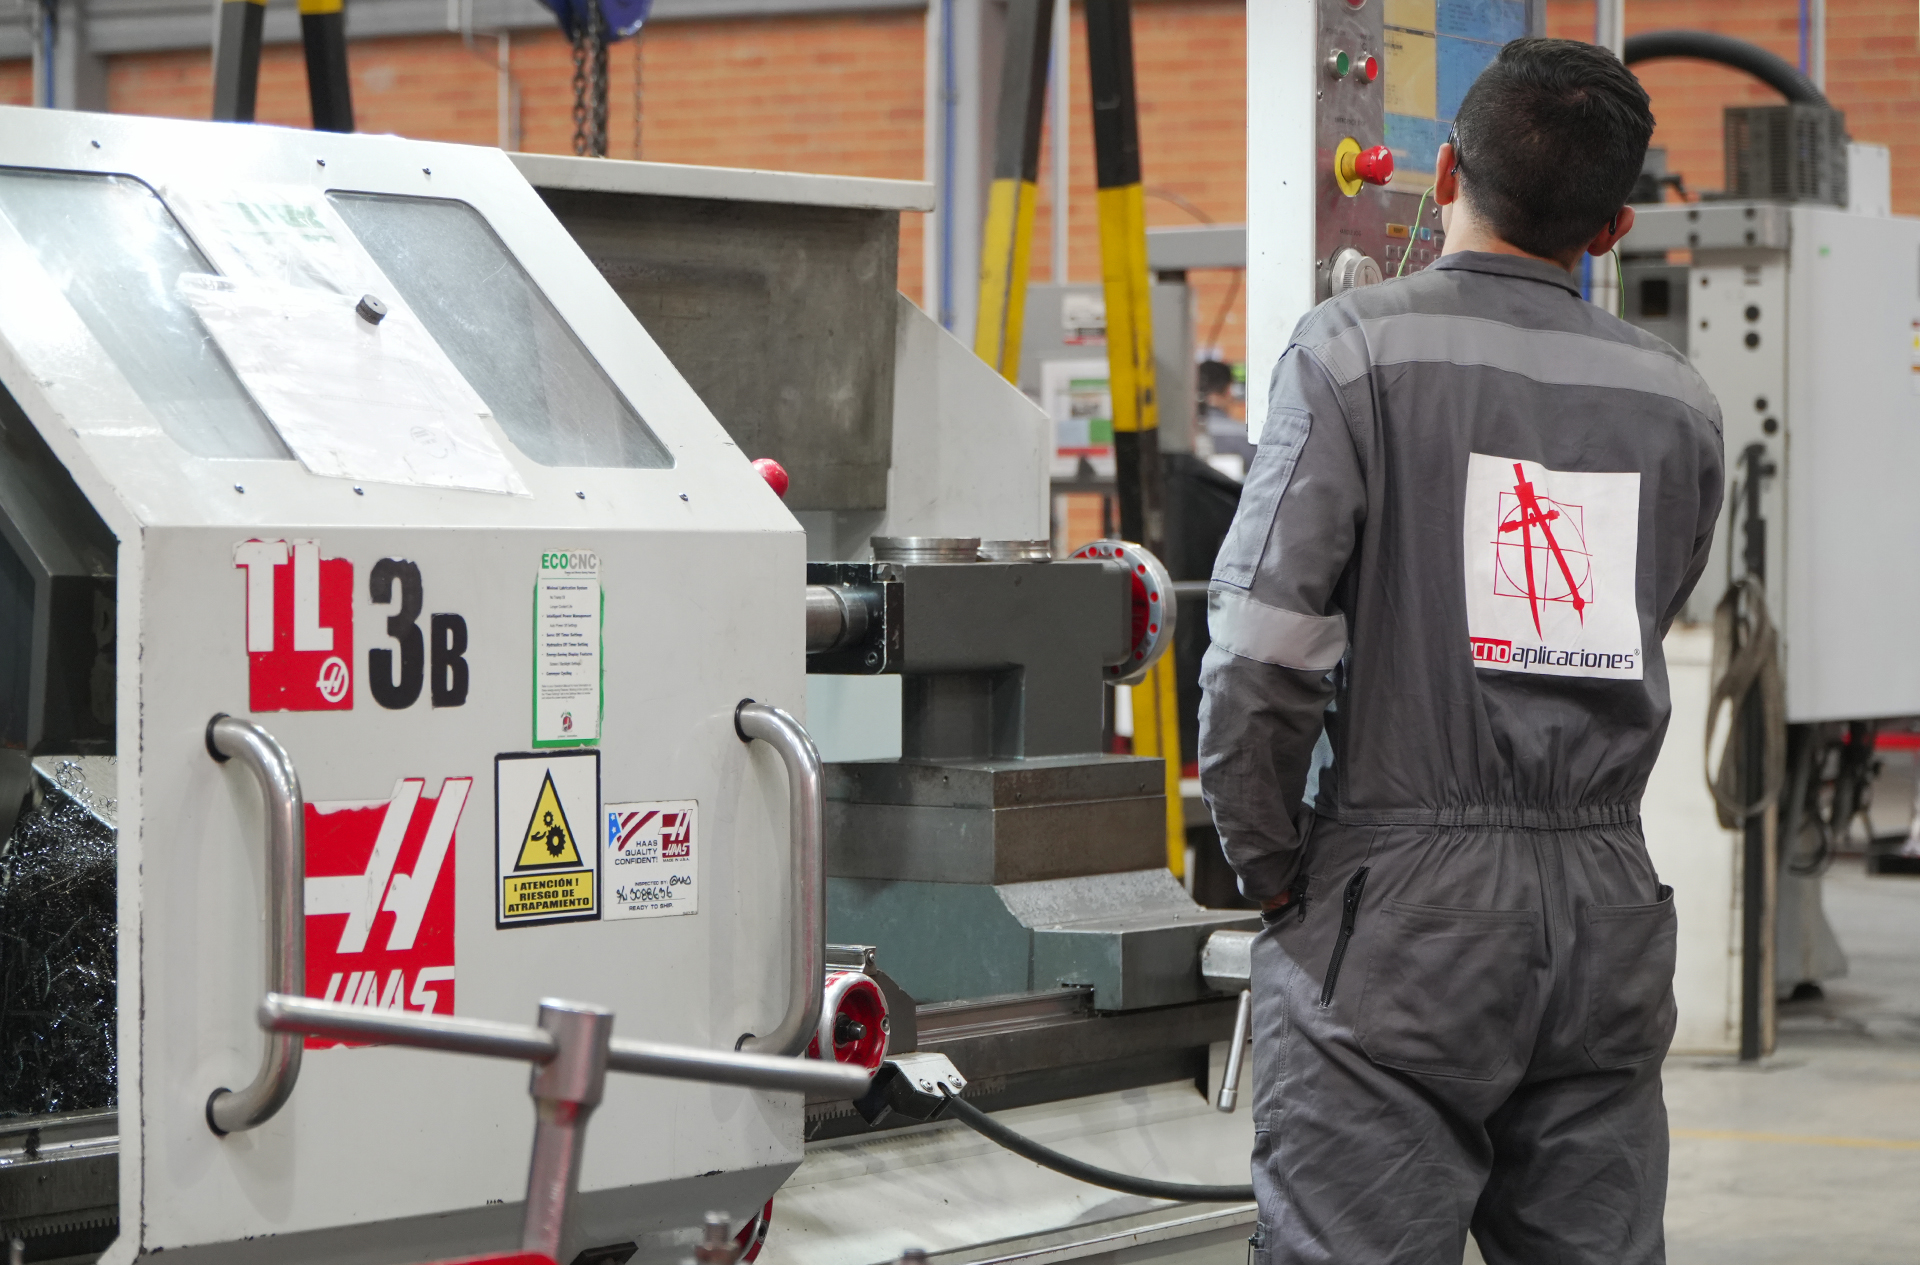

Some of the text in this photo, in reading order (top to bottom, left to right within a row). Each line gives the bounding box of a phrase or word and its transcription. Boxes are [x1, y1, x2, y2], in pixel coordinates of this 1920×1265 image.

[542, 553, 596, 569] ECOCNC
[232, 538, 334, 652] TL
[636, 840, 658, 848] HAAS
[625, 848, 658, 857] QUALITY
[614, 857, 659, 865] CONFIDENT!
[520, 878, 575, 892] ATENCIÓN
[519, 889, 575, 902] RIESGO DE
[507, 897, 590, 913] ATRAPAMIENTO
